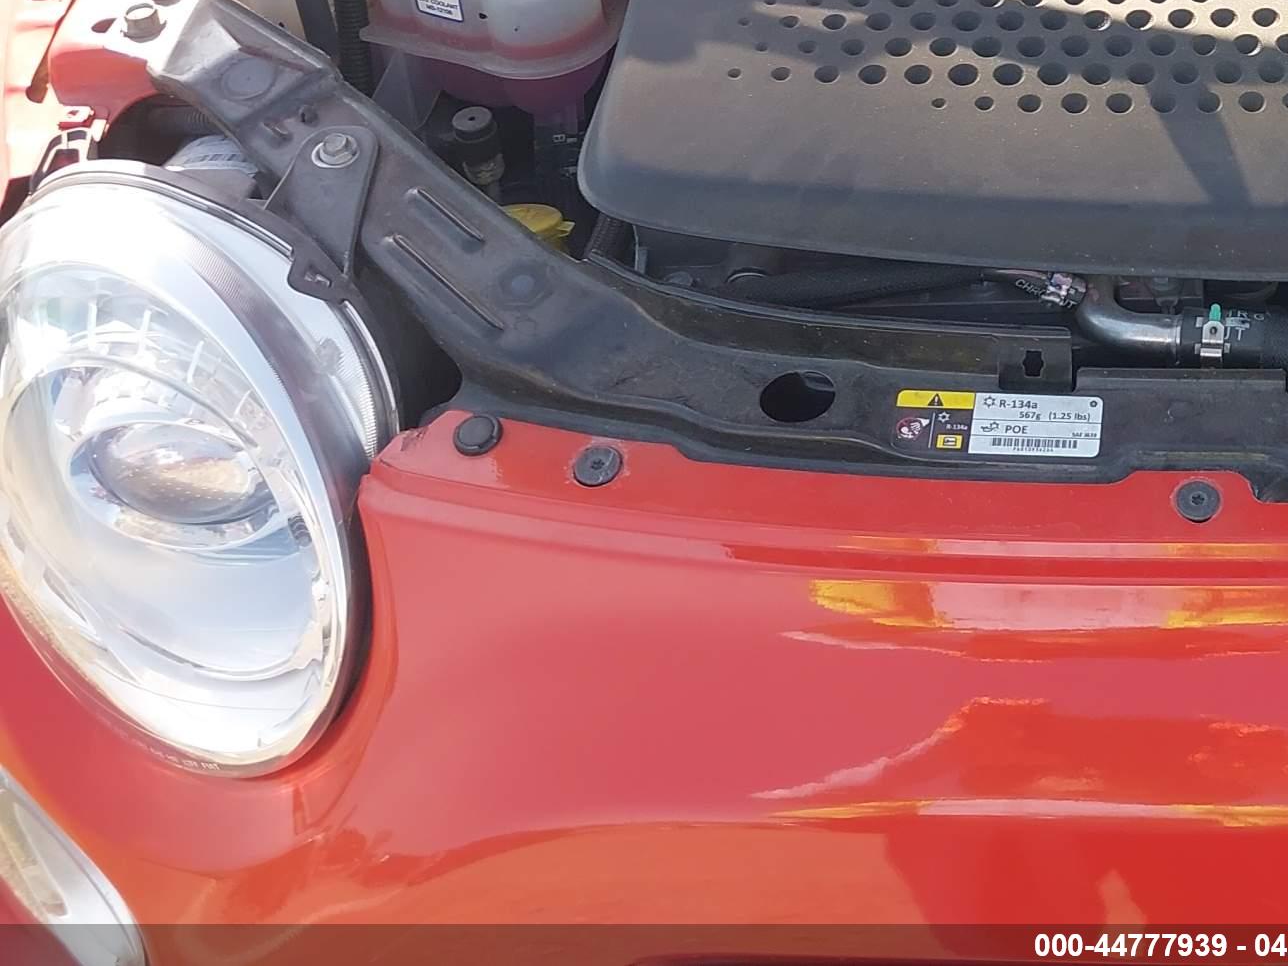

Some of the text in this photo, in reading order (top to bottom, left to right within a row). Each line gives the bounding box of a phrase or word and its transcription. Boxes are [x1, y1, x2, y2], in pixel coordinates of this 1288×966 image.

[999, 399, 1038, 409] R-134a
[1019, 411, 1091, 422] 567g (1.25 lbs)
[1005, 425, 1028, 434] POE
